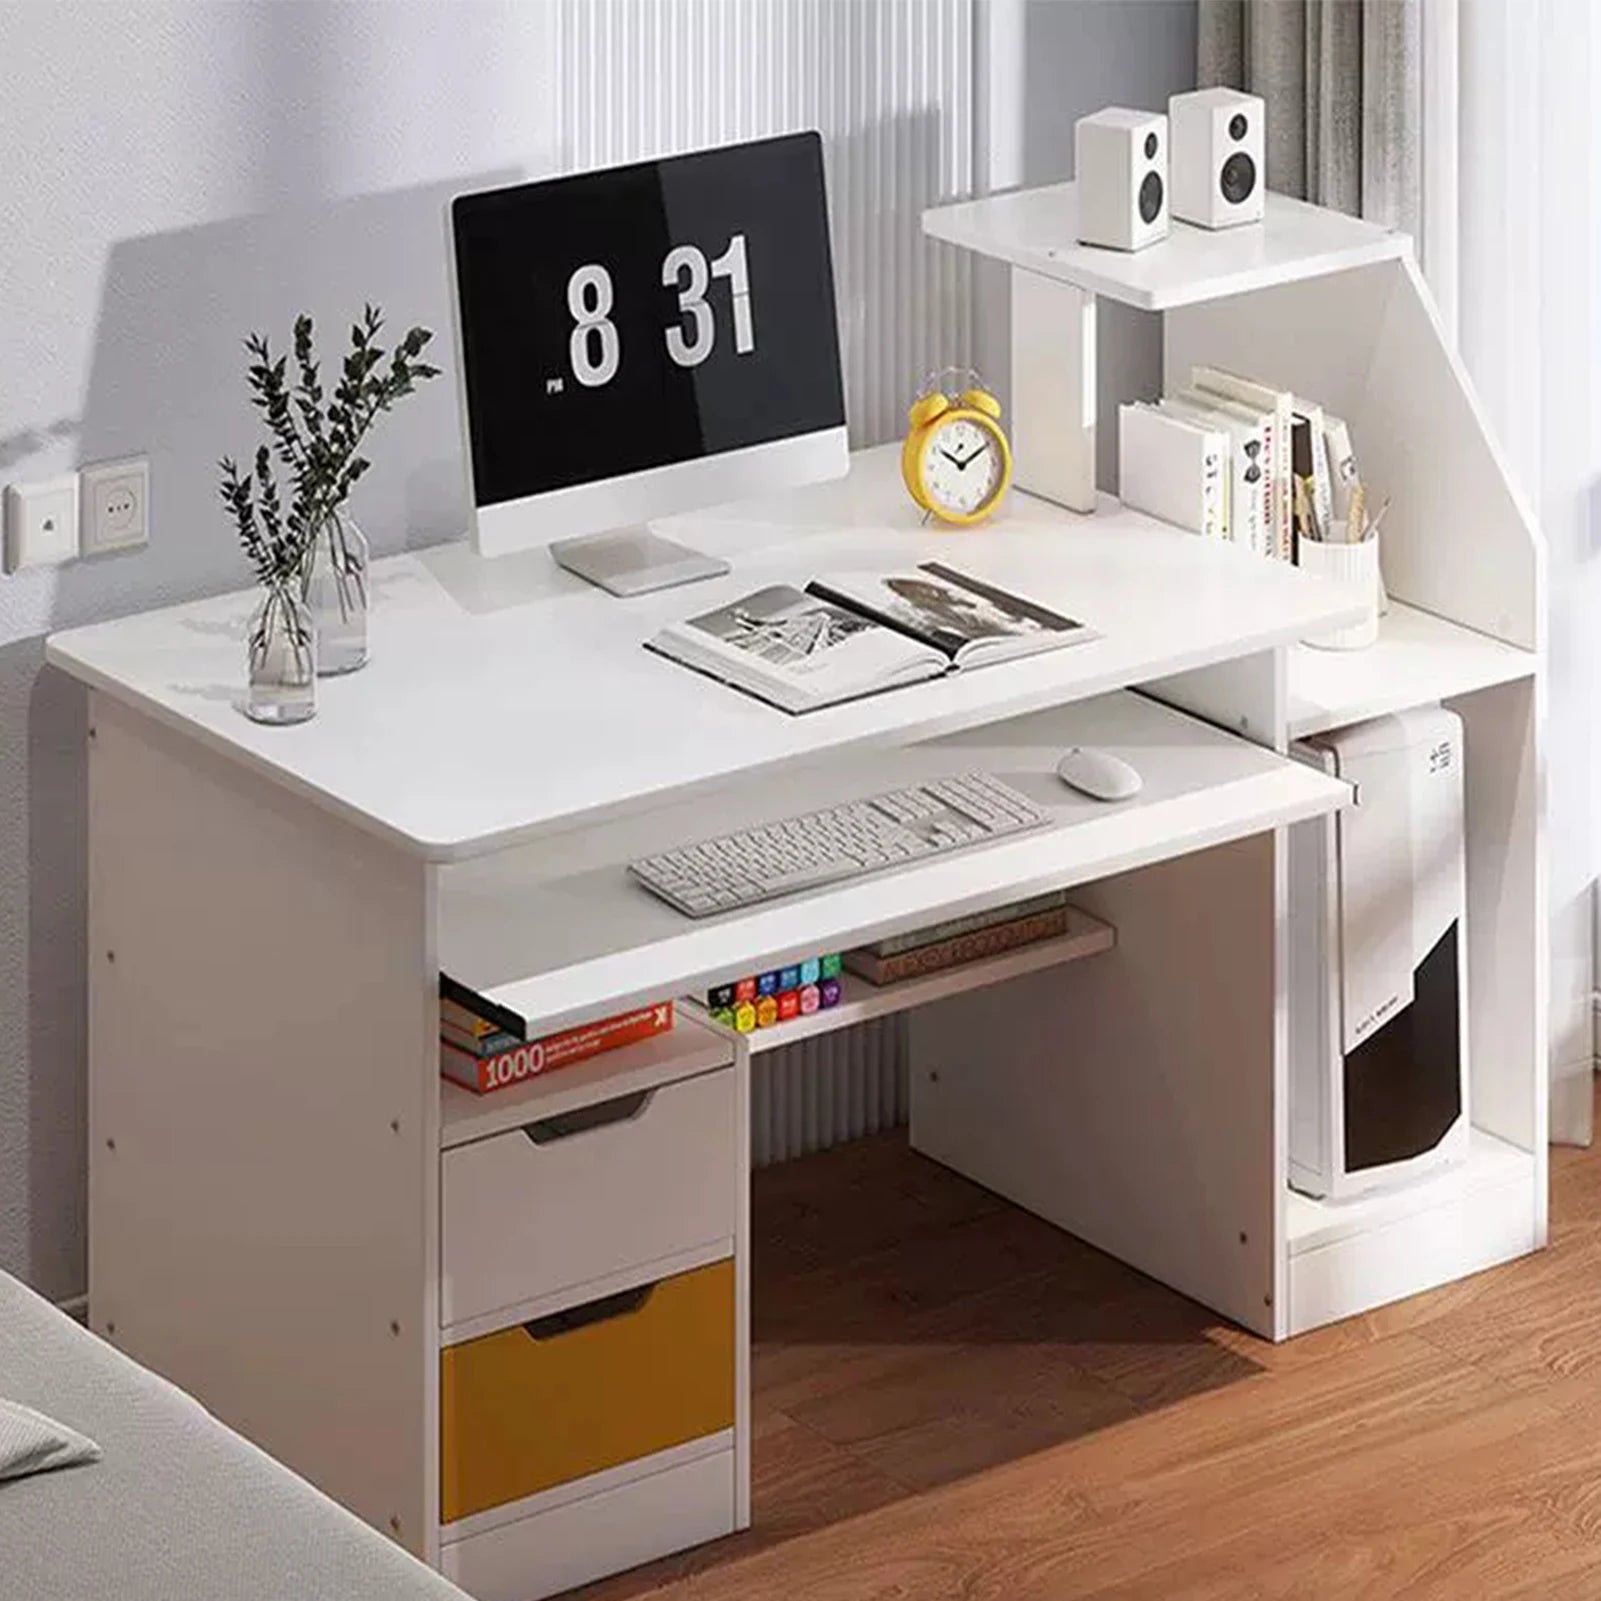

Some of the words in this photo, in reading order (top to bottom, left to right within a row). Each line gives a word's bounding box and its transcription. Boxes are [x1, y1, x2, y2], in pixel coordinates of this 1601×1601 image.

[567, 264, 620, 387] 8
[662, 234, 754, 367] 31
[486, 1043, 544, 1088] 1000
